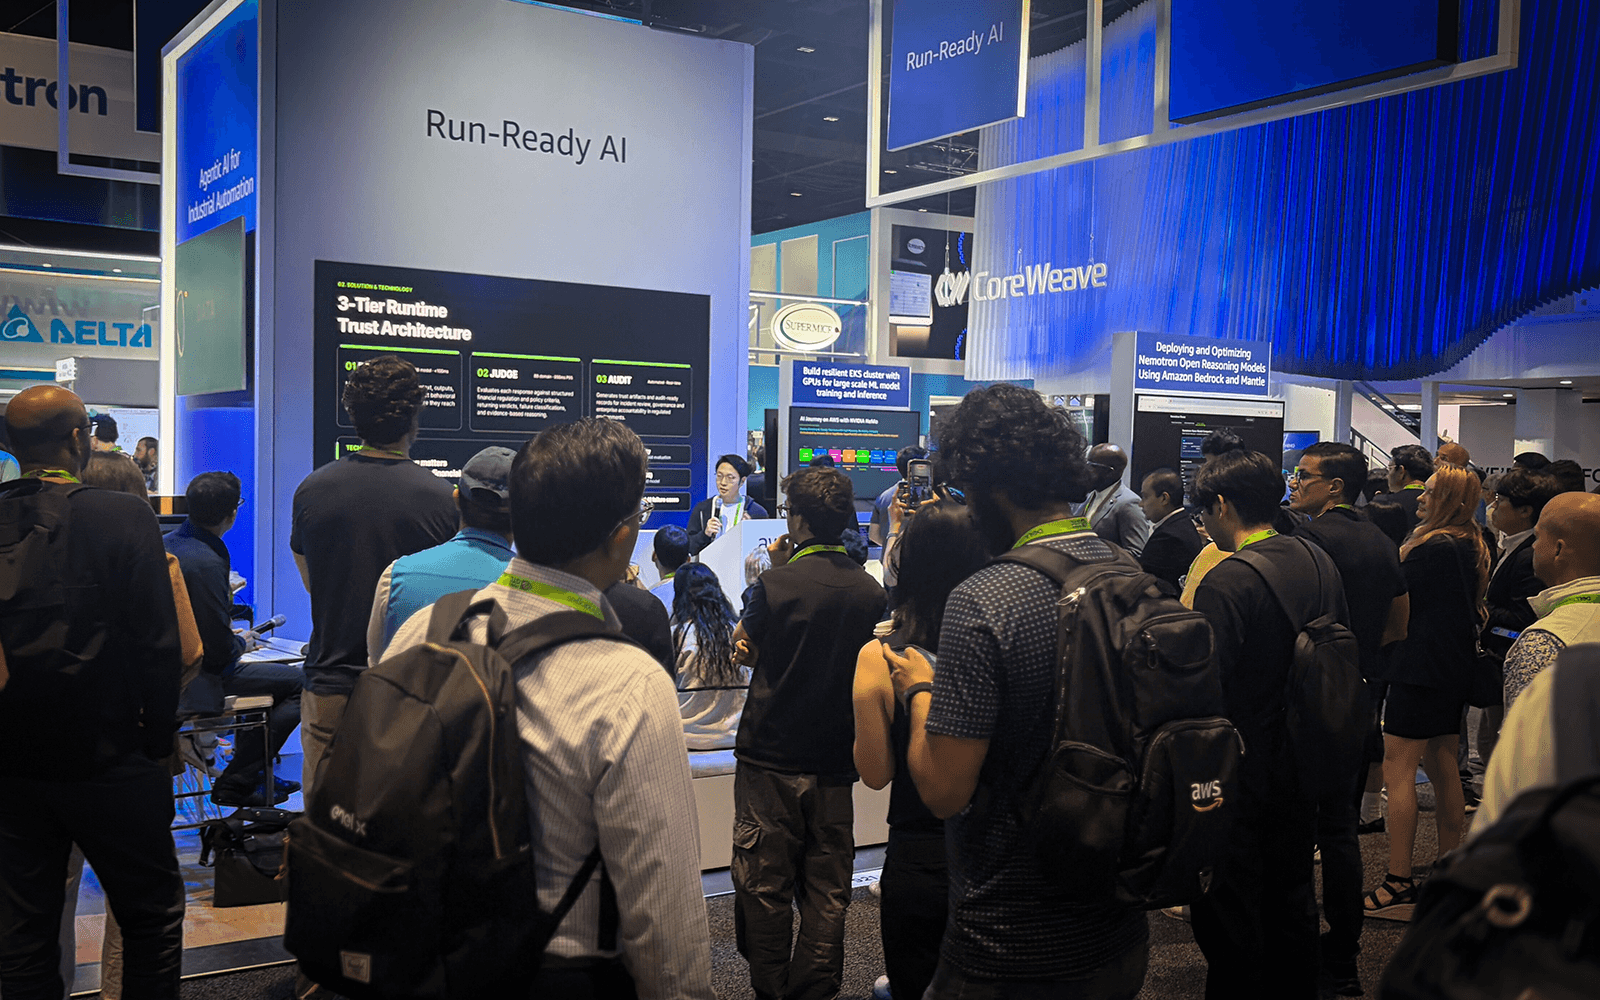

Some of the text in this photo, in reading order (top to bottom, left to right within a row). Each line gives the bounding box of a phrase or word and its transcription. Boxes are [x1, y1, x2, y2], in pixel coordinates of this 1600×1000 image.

[906, 21, 1004, 72] Run-Ready AI
[426, 108, 626, 166] Run-Ready AI
[199, 148, 241, 191] Agentic AI for
[188, 176, 254, 224] Industrial Automation
[347, 282, 373, 290] SOLUTION
[378, 284, 413, 293] TECHNOLOGY
[973, 262, 1107, 301] CoreWeave
[337, 295, 448, 319] 3-Tier Runtime
[50, 318, 152, 348] DELTA
[336, 317, 472, 341] Trust Architecture
[1156, 342, 1251, 361] Deploying and Optimizing
[345, 361, 356, 371] 01
[1138, 355, 1266, 373] Nemotron Open Reasoning Models
[477, 368, 519, 379] 02 JUDGE
[596, 375, 632, 385] 03 AUDIT
[803, 367, 900, 380] Build resilient EKS cluster with
[1138, 369, 1265, 387] Using Amazon Bedrock and Mantle
[477, 386, 500, 394] Evaluates
[803, 377, 900, 390] GPUs for large scale ML model
[816, 389, 887, 400] training and inference
[534, 404, 566, 412] classifications,
[1190, 780, 1222, 800] aws
[330, 804, 354, 830] enel
